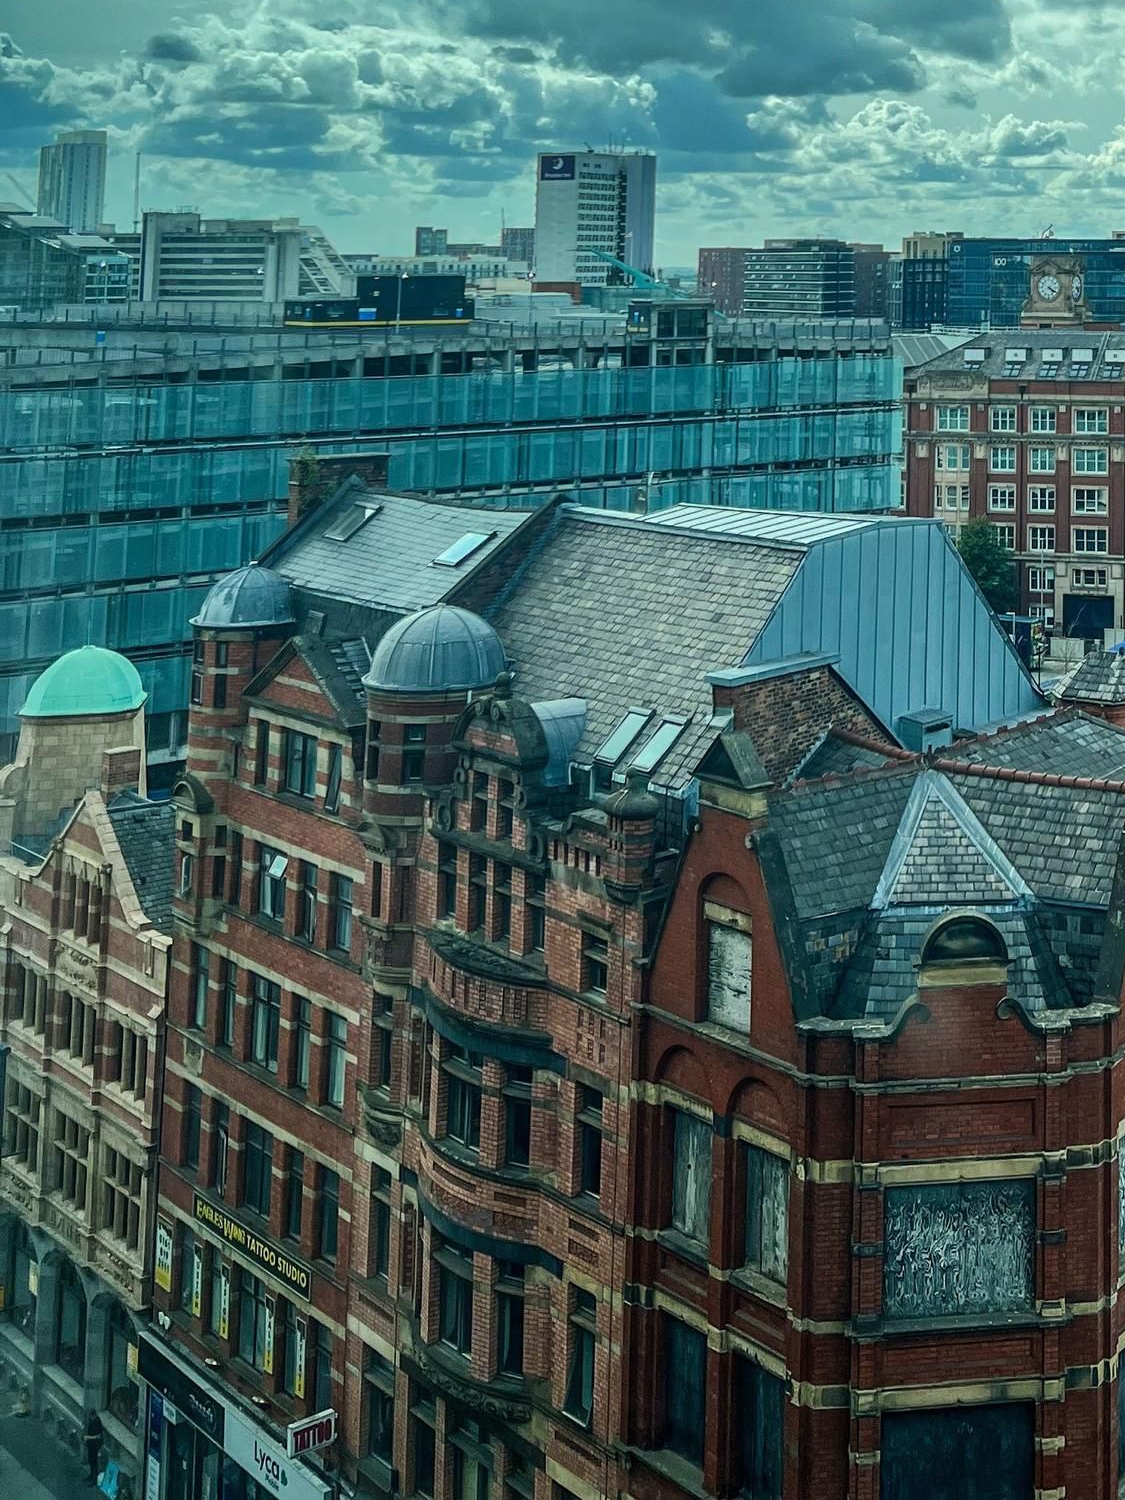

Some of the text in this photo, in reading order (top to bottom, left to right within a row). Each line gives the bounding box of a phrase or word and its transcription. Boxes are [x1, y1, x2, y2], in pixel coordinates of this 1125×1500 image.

[246, 1234, 277, 1267] TATTOO
[277, 1256, 307, 1289] STUDIO
[254, 1440, 280, 1482] Lyca
